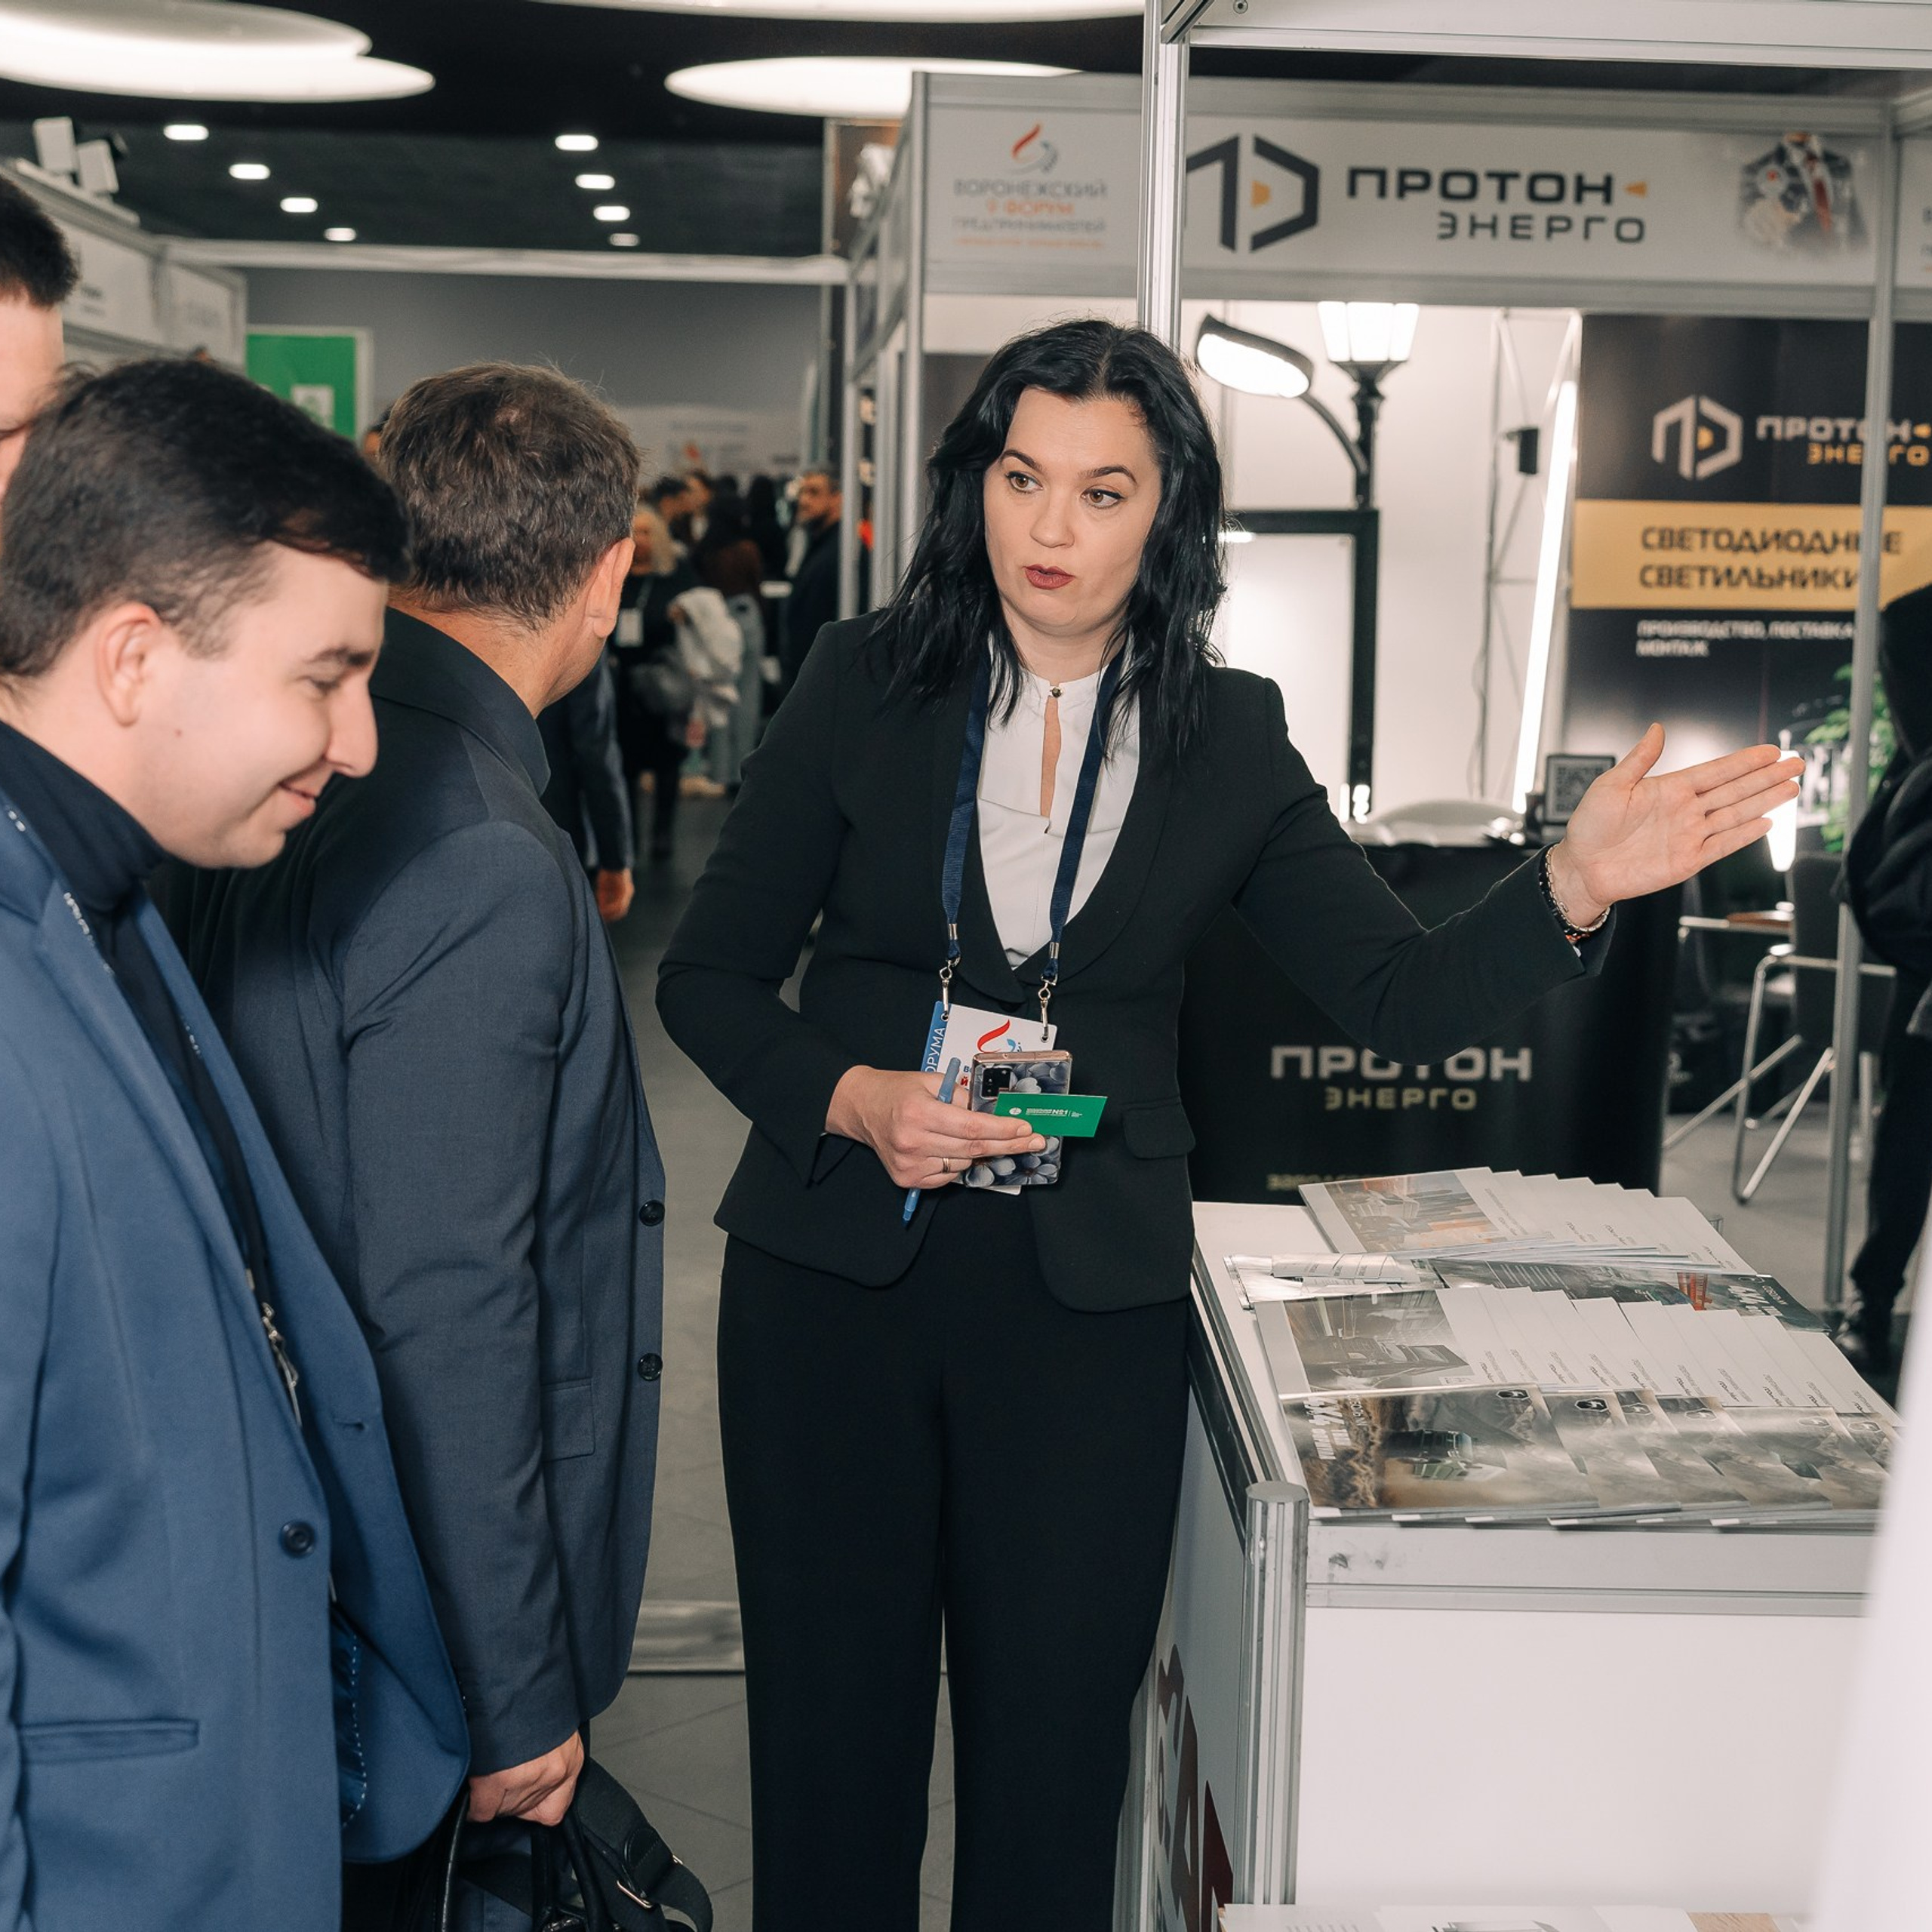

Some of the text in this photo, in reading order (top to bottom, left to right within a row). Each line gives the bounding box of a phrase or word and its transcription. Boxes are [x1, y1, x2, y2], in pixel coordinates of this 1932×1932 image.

[1347, 167, 1614, 205] ПРОТОН
[1437, 211, 1646, 244] ЭНЕРГО
[1807, 442, 1930, 466] ЭНЕГО
[1641, 527, 1903, 555] СВЕТОДИОДНЕ
[925, 1027, 946, 1072] ОРУМА
[1324, 1087, 1478, 1111] ЭНЕРГО
